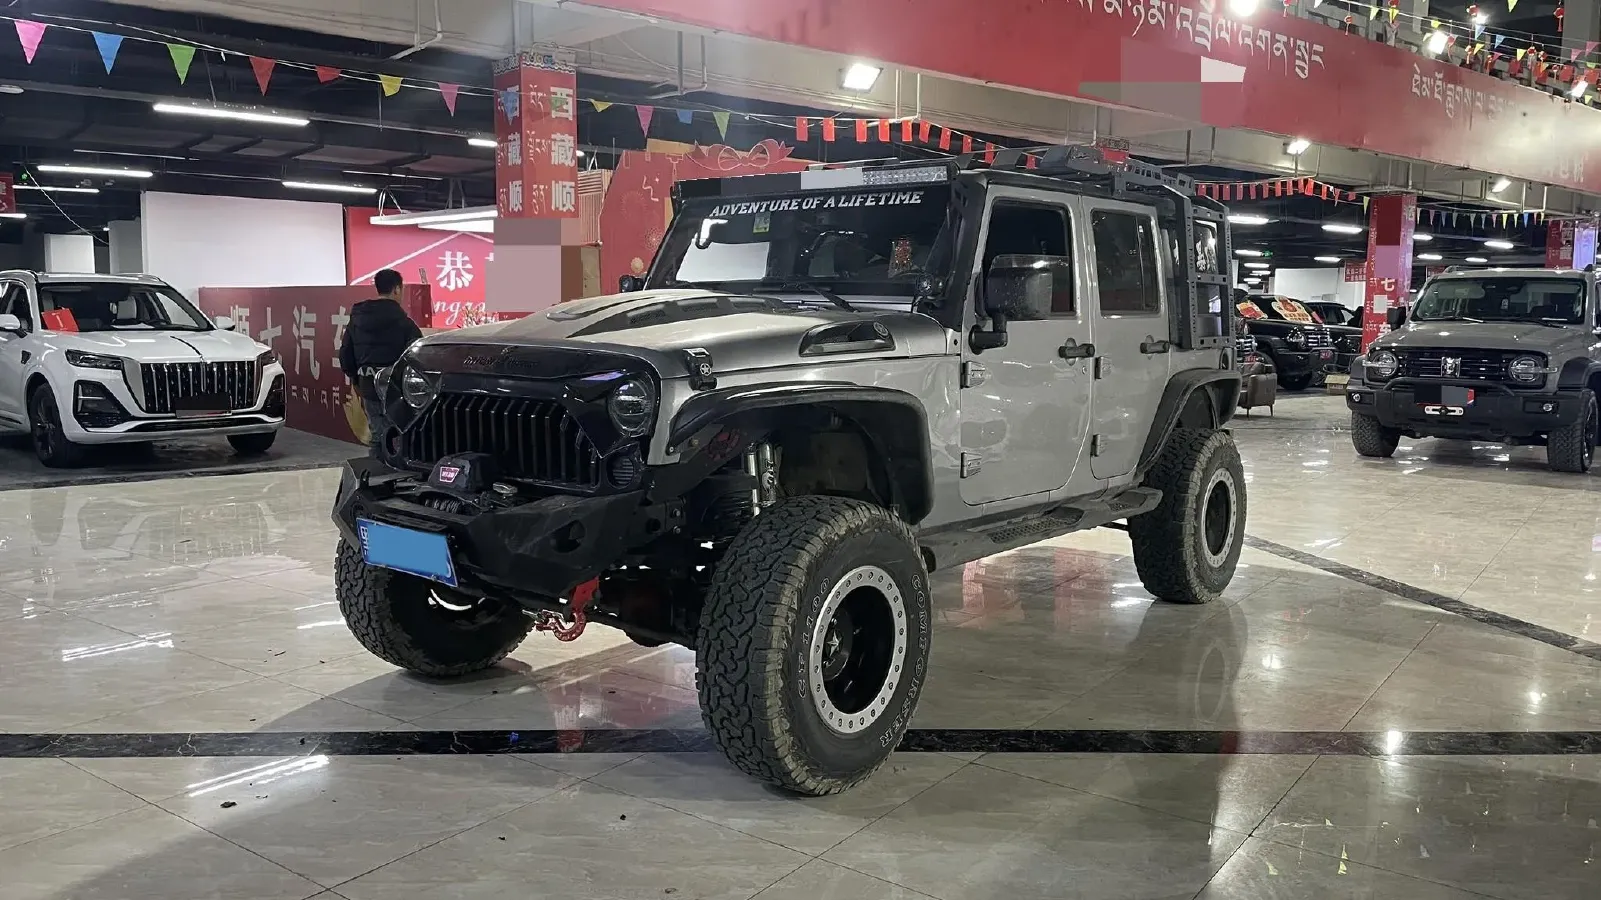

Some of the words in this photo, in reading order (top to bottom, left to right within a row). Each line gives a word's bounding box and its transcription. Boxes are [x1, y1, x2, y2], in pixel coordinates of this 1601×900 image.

[550, 86, 575, 213] 西藏顺
[709, 198, 801, 217] ADVENTURE
[802, 196, 824, 210] OF
[823, 195, 836, 208] A
[838, 191, 925, 207] LIFETIME
[798, 577, 830, 699] CF1100
[879, 574, 927, 748] COMFORSER
